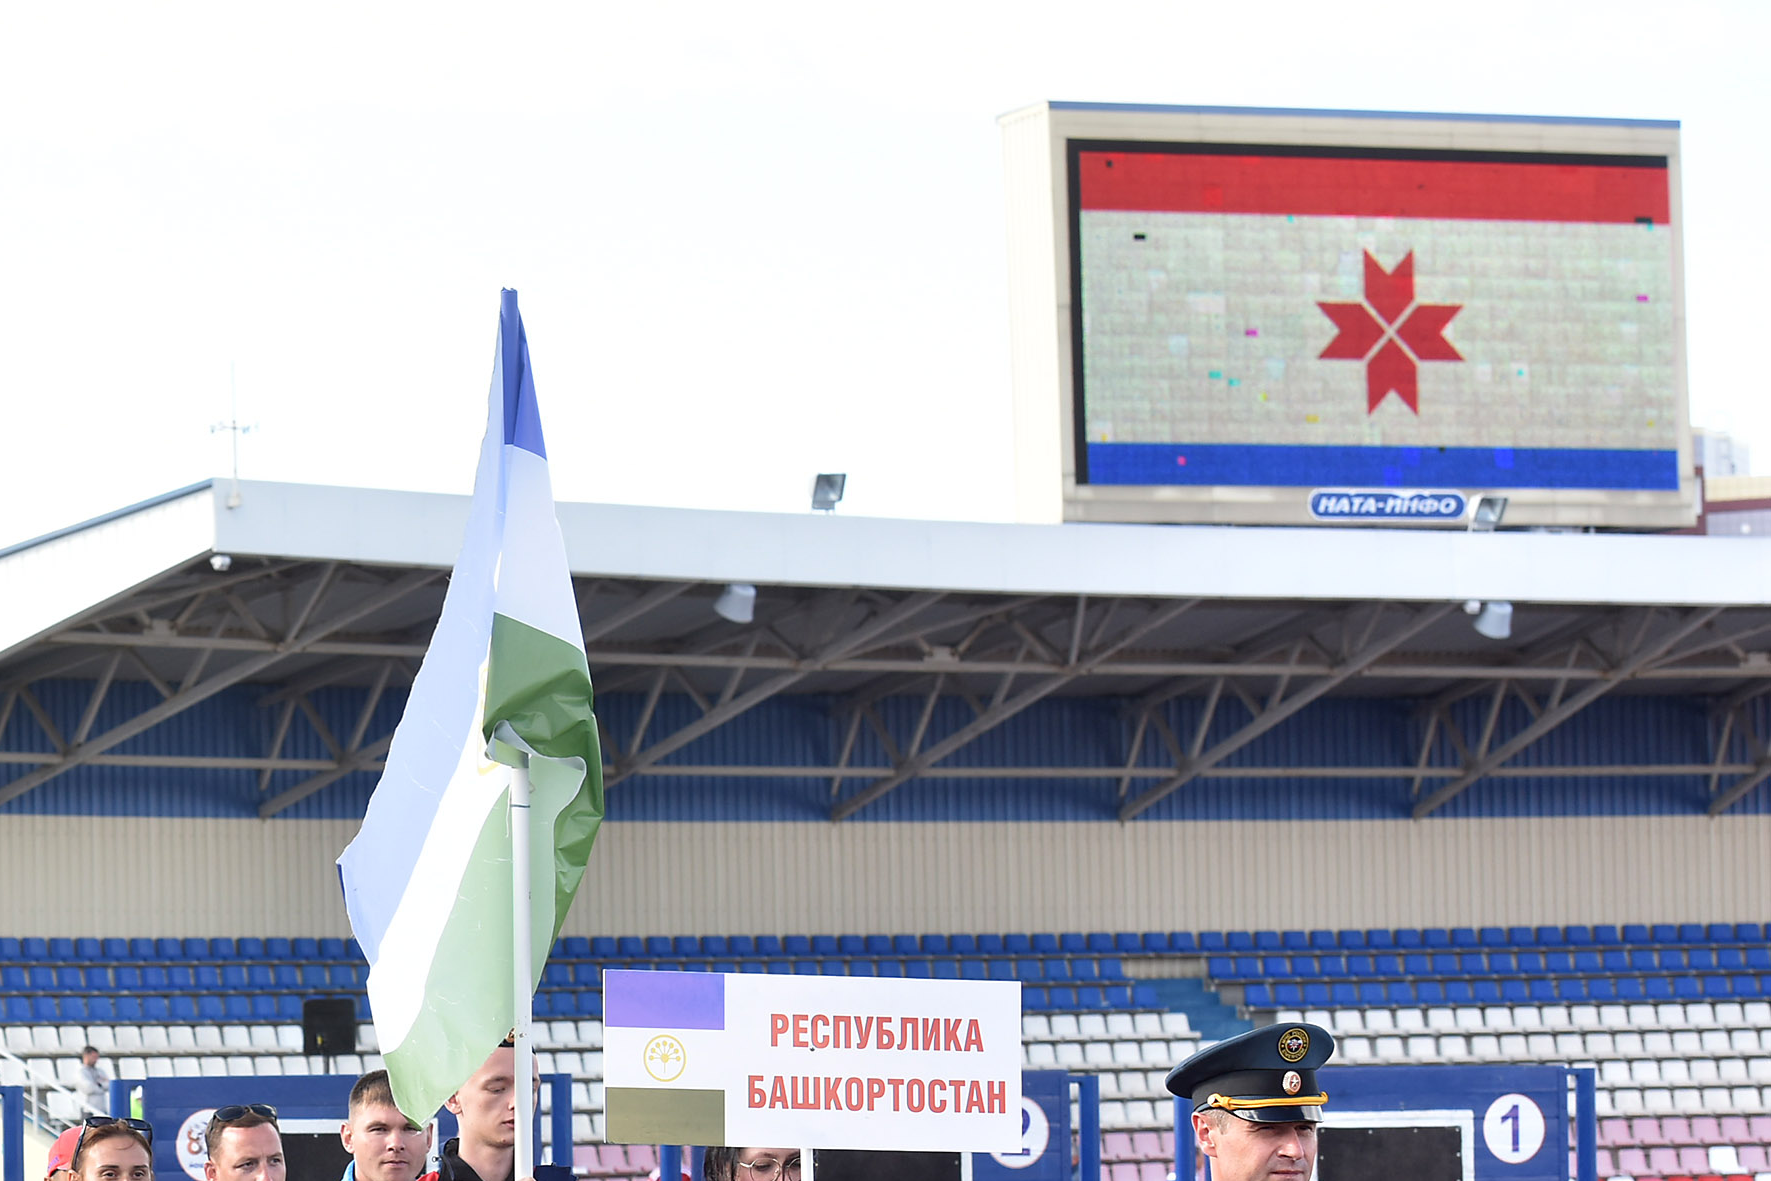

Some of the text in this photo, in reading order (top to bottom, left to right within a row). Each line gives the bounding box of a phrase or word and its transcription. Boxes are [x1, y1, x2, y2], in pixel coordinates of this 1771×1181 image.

[770, 1013, 985, 1052] РЕСПУБЛИКА
[747, 1075, 1007, 1114] БАШКОРТОСТАН
[1500, 1104, 1519, 1152] 1
